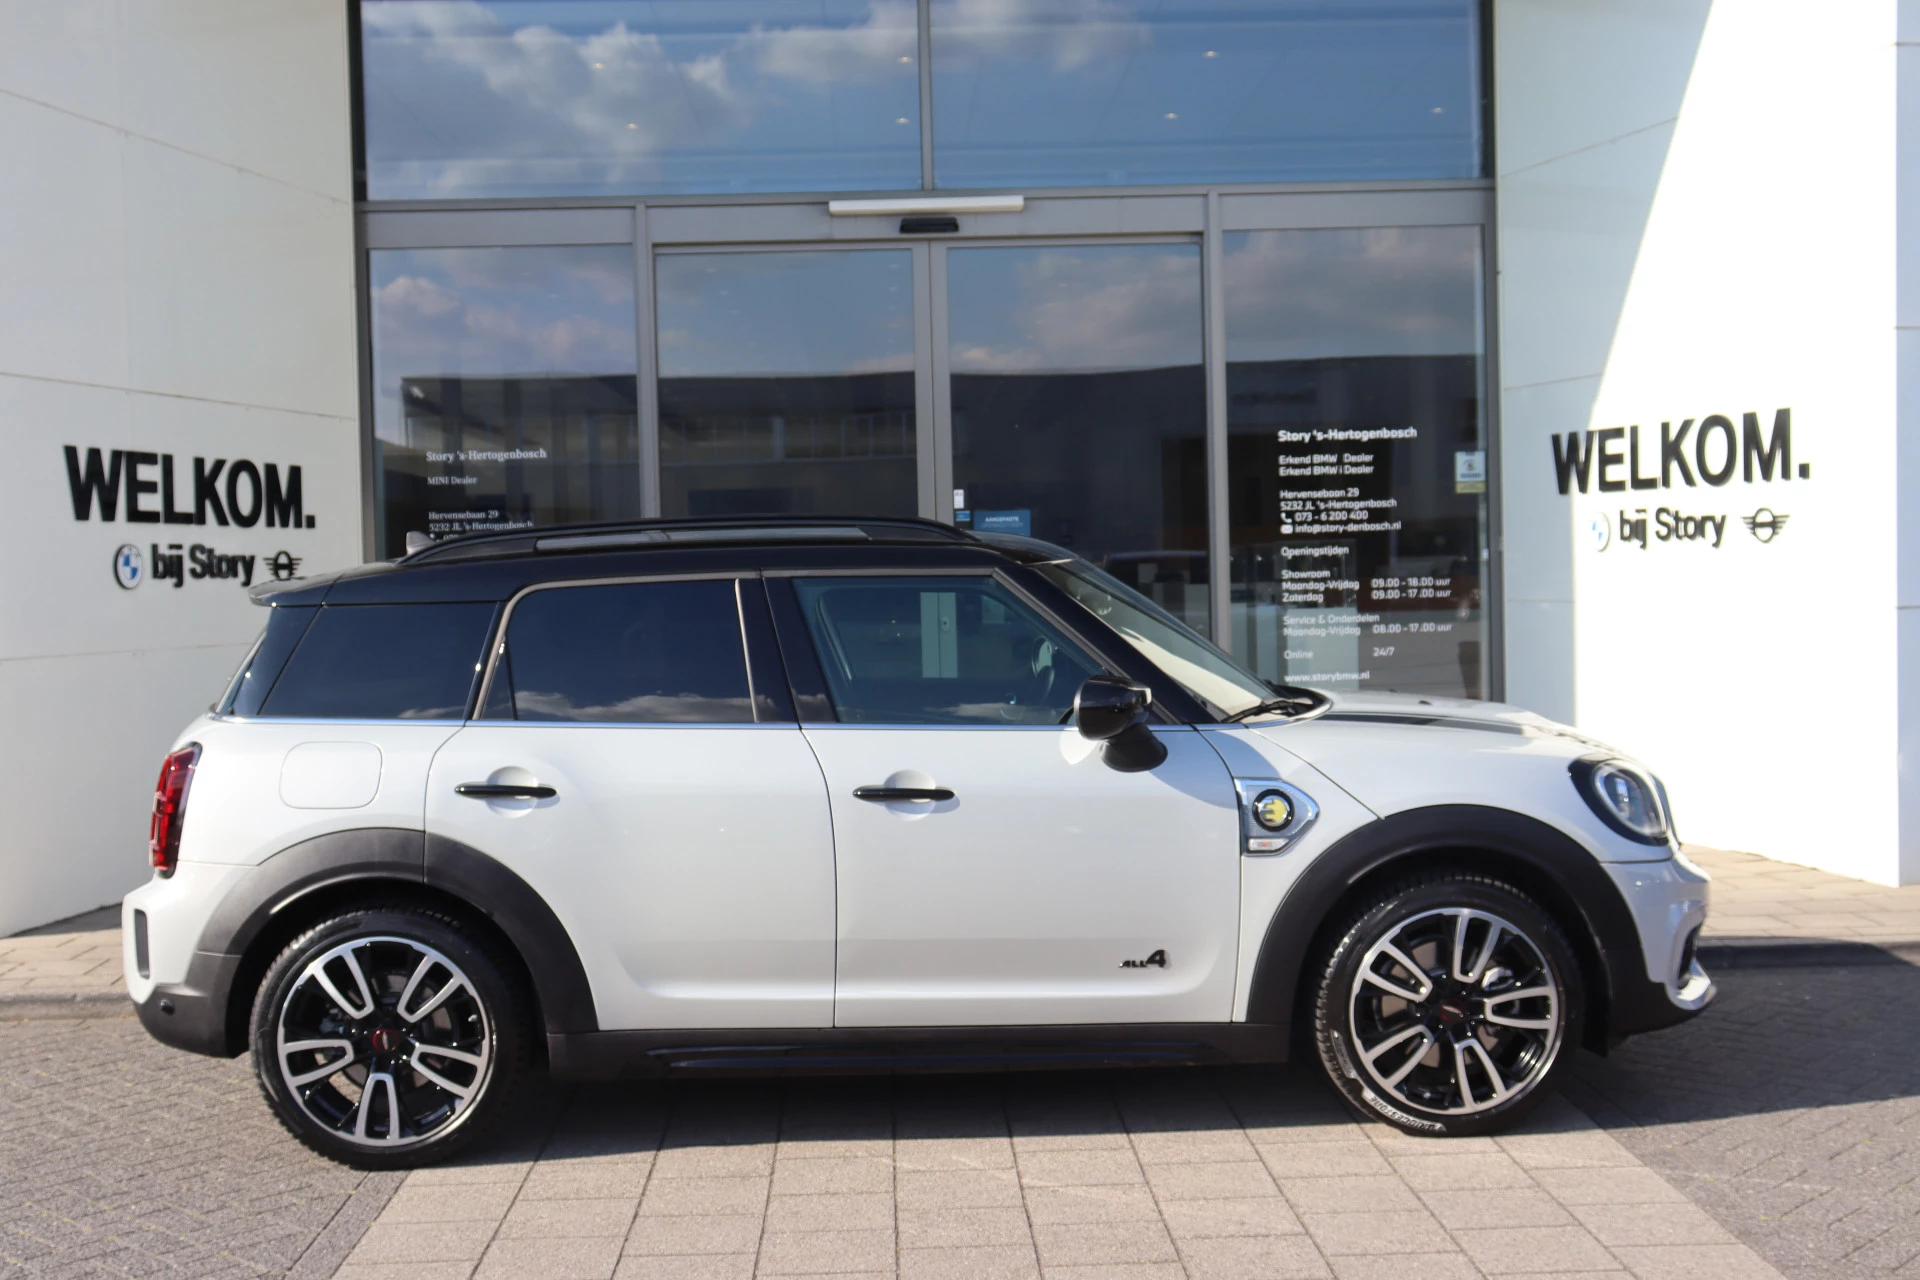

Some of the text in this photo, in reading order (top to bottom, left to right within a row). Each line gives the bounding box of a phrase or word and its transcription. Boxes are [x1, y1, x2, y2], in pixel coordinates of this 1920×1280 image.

[1277, 430, 1311, 444] Story
[426, 451, 454, 464] Story
[1551, 407, 1810, 495] WELKOM.
[1278, 453, 1374, 465] Erkend BMW Dealer
[1279, 466, 1311, 477] Erkend
[1313, 465, 1338, 476] BMW
[1344, 464, 1374, 475] Dealer
[62, 444, 316, 529] WELKOM.
[427, 476, 477, 485] MINI Dealer
[1280, 488, 1360, 499] Hervensebaan 29
[1280, 500, 1304, 511] 5232
[1304, 500, 1315, 510] JL
[428, 510, 499, 520] Hervensebaan 29
[1294, 511, 1312, 522] 073
[1320, 511, 1327, 521] 6
[1328, 511, 1348, 521] 200
[1349, 510, 1369, 520] 400
[429, 522, 450, 532] 5232
[1295, 521, 1402, 534] info@story-denbosch.nl
[1619, 506, 1727, 550] bij Story
[1281, 545, 1349, 558] Openingstijden
[151, 543, 256, 589] bij Story
[1281, 569, 1330, 579] Showroom
[1281, 579, 1360, 592] Maandag-Vrijdag
[1371, 578, 1400, 588] 09.00
[1408, 577, 1434, 587] 18.00
[1436, 579, 1451, 587] uur
[1282, 592, 1324, 604] Zaterdag
[1371, 589, 1400, 600] 09.00
[1436, 590, 1452, 598] uur
[1283, 612, 1380, 625] Service & Onderdelen
[1283, 624, 1361, 638] Maandag-Vrijdag
[1373, 624, 1402, 634] 08.00
[1437, 624, 1452, 632] uur
[1284, 647, 1395, 660] Online 24/7
[1284, 670, 1370, 683] www.storybmw.nl
[1119, 949, 1166, 968] ALL4
